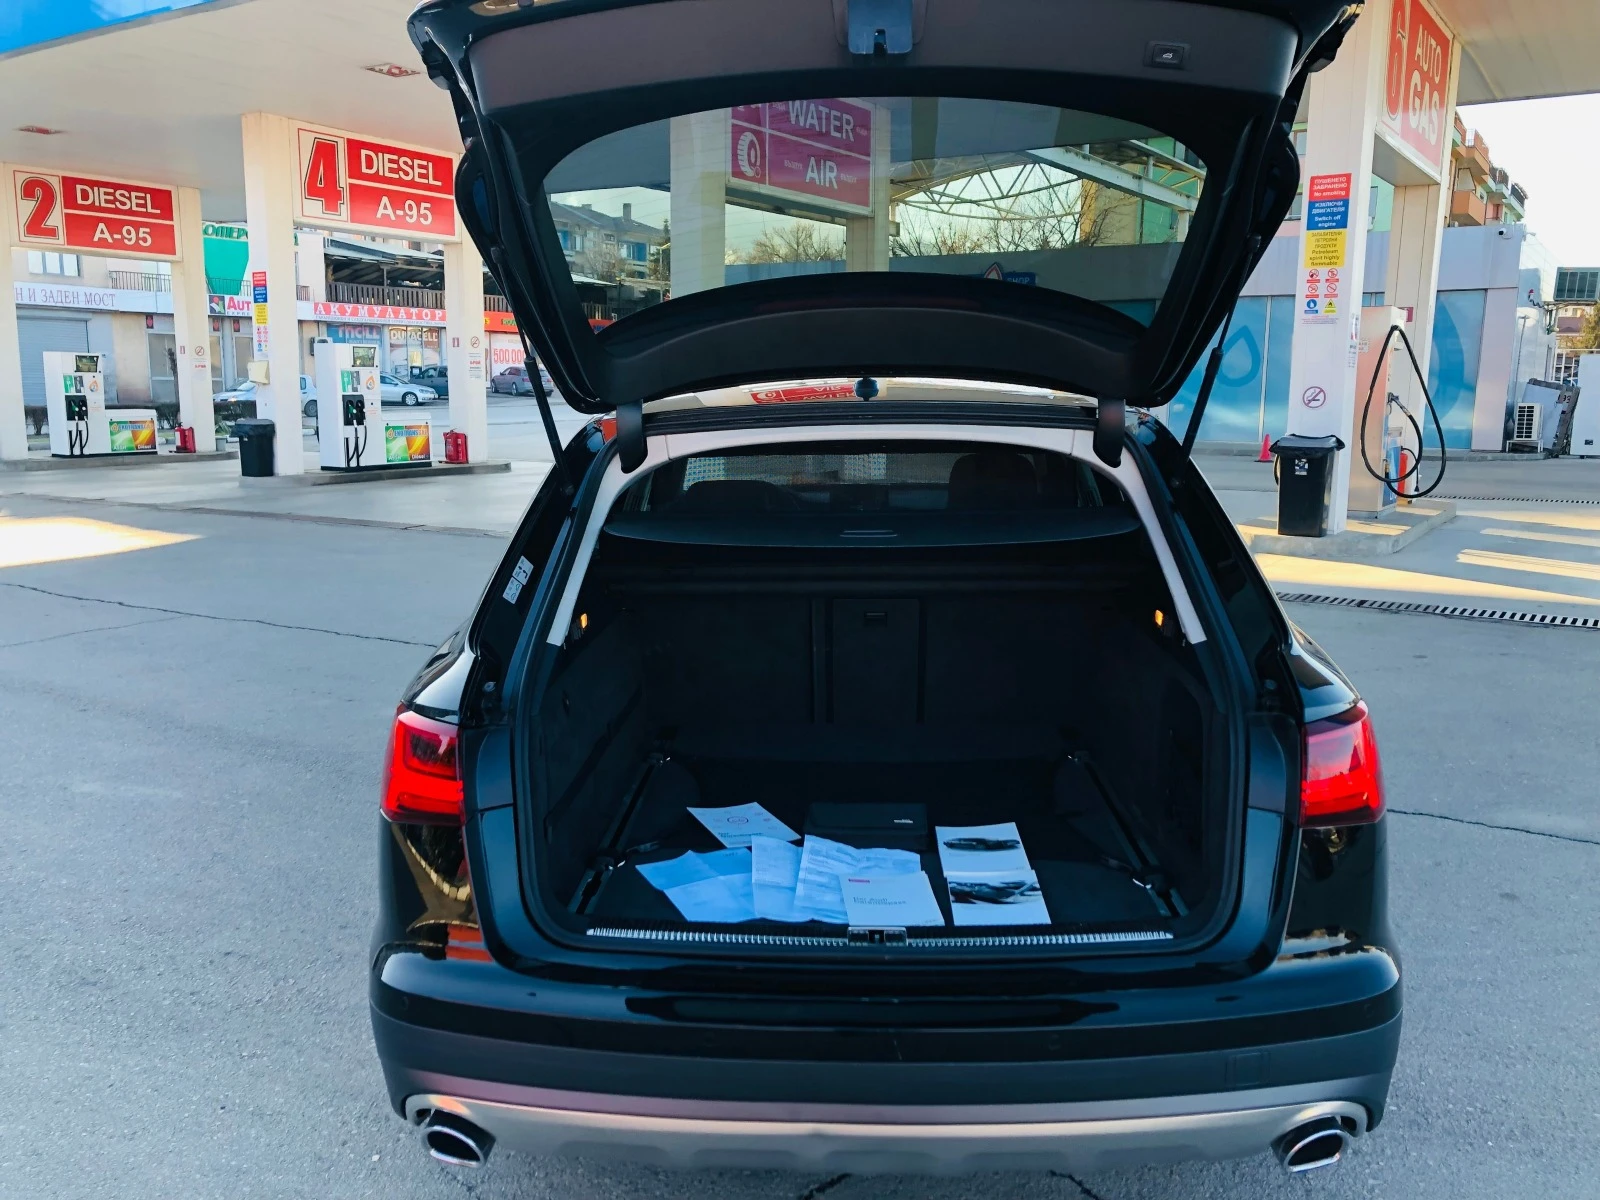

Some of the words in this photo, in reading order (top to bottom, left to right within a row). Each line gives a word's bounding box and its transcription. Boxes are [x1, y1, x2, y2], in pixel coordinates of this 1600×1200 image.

[1415, 24, 1442, 84] AUTO
[788, 99, 855, 142] WATER
[1409, 69, 1440, 146] GAS
[304, 137, 344, 216] 4
[361, 149, 442, 186] DIESEL
[805, 156, 838, 190] AIR
[21, 177, 59, 240] 2
[76, 184, 161, 214] DIESEL
[28, 289, 36, 302] И
[41, 289, 79, 305] ЗАДЕН
[84, 292, 116, 307] МОСТ
[315, 302, 443, 320] АКУМУЛАТОР
